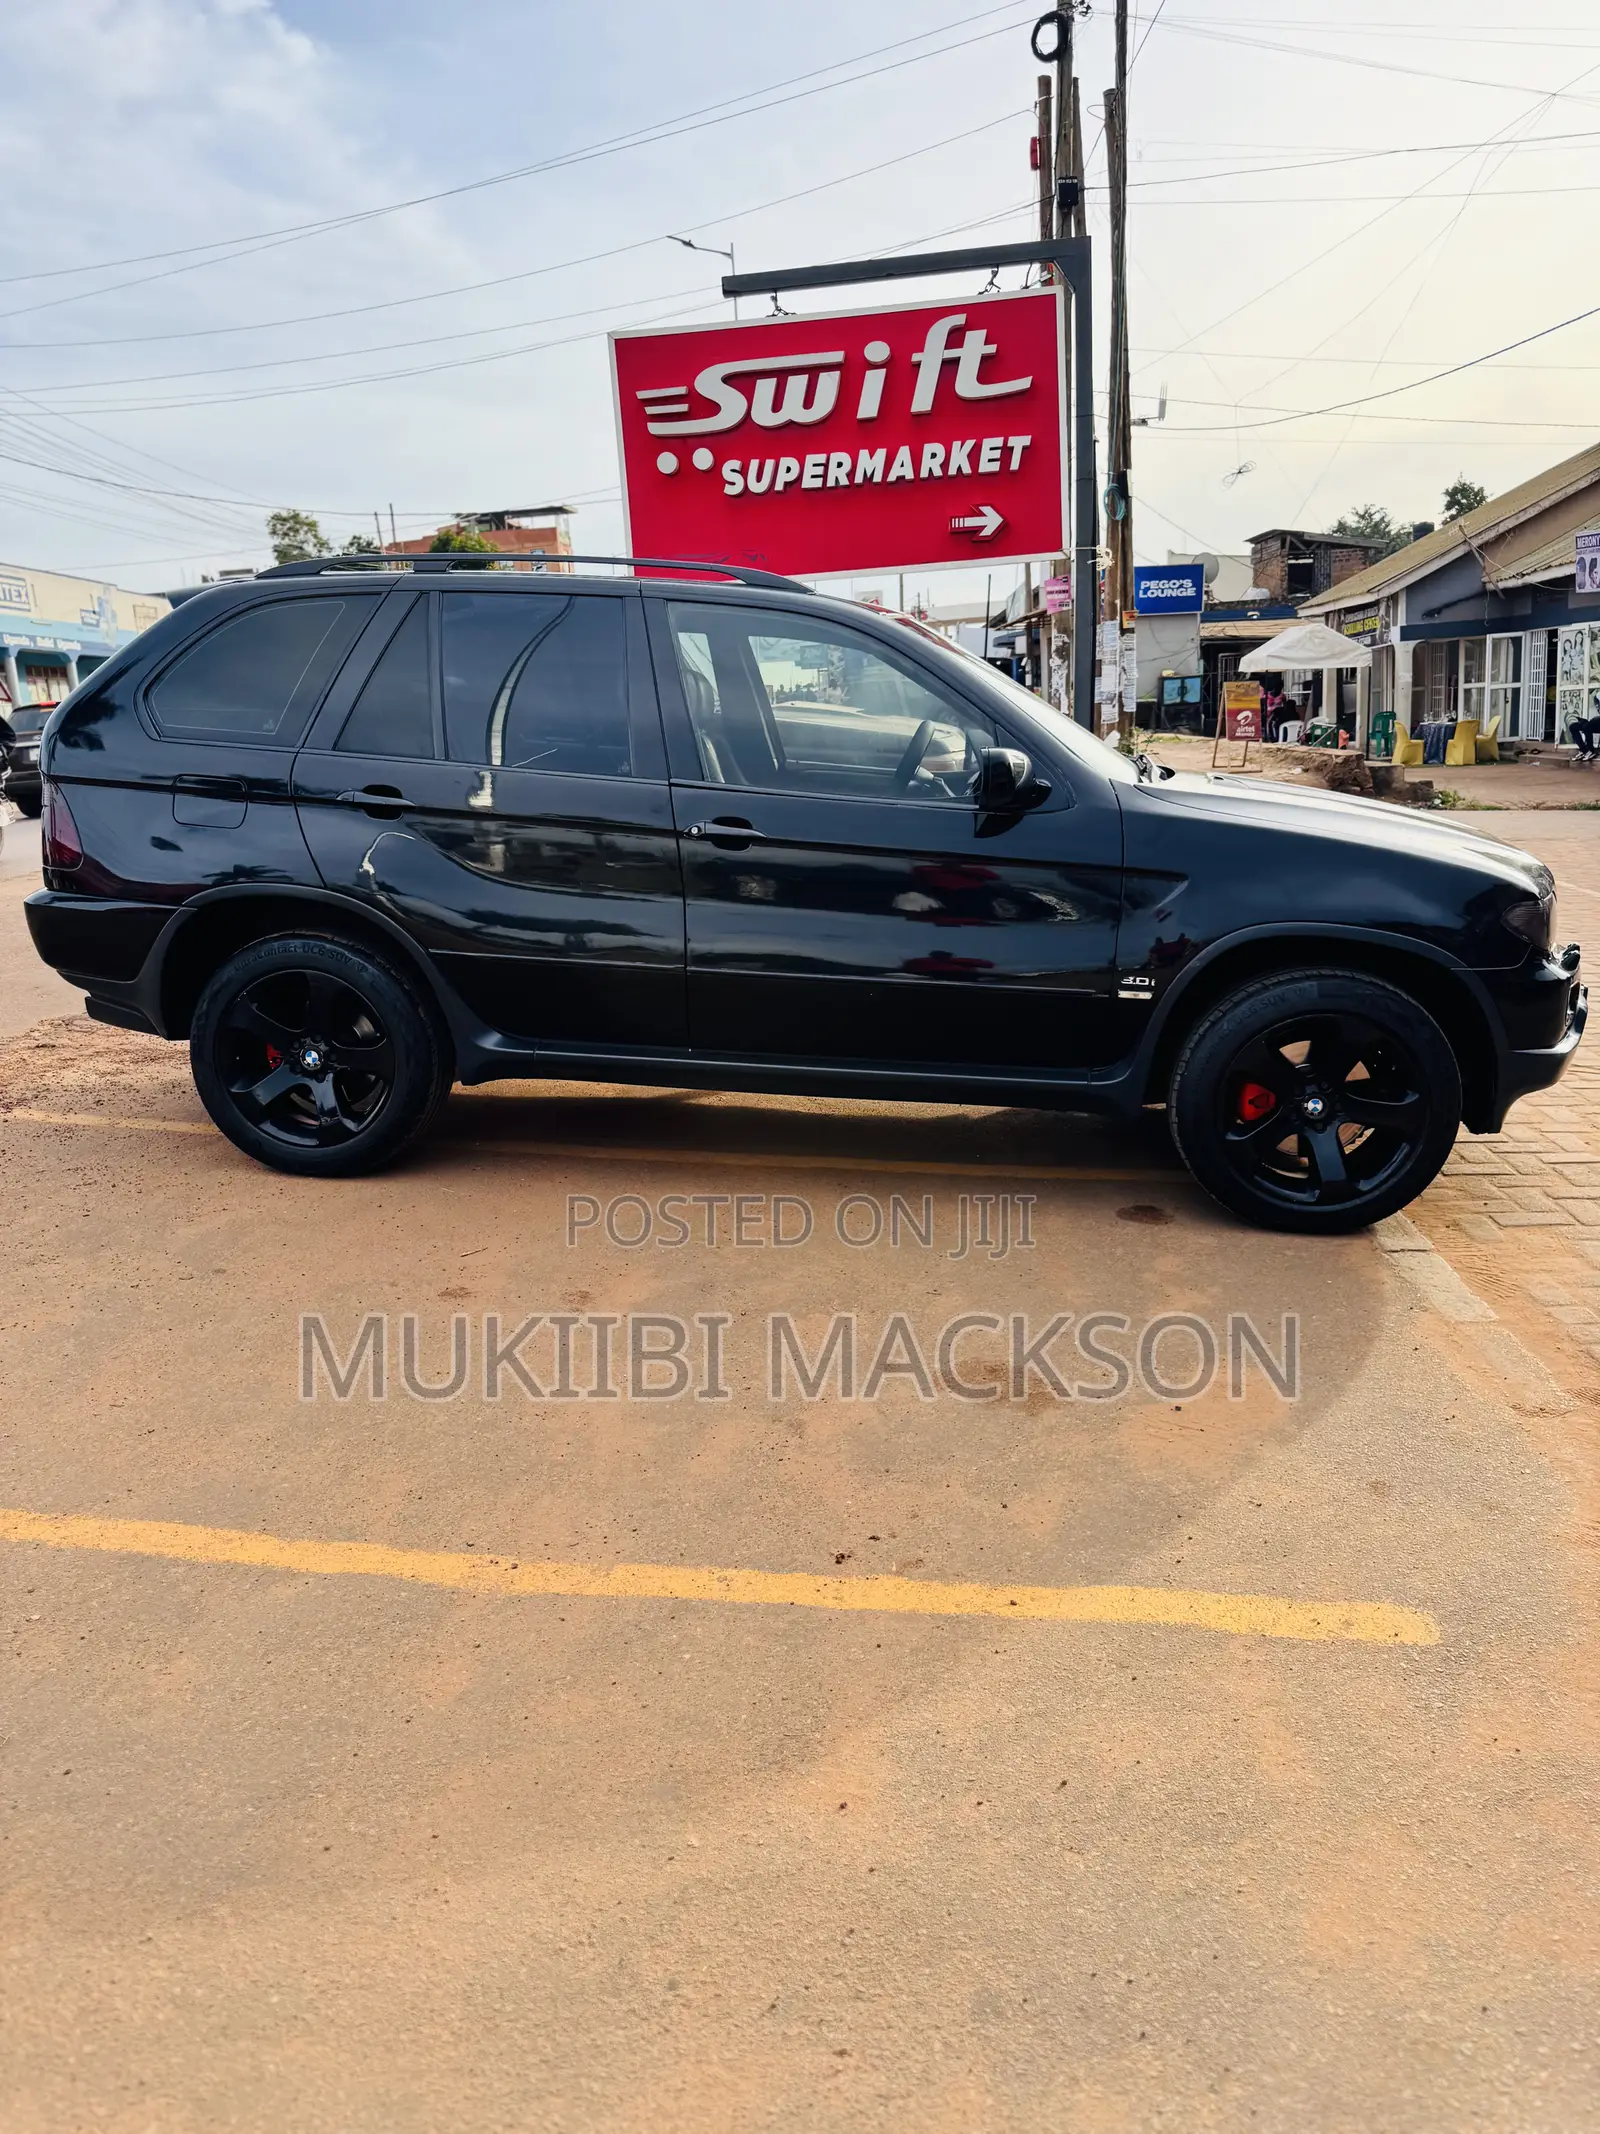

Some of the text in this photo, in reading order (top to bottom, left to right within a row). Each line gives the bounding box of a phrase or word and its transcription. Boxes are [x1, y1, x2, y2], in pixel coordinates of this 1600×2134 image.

[636, 313, 1033, 437] Swift
[721, 434, 1032, 496] SUPERMARKET
[1139, 588, 1197, 598] LOUNGE
[1140, 579, 1193, 589] PEGO'S
